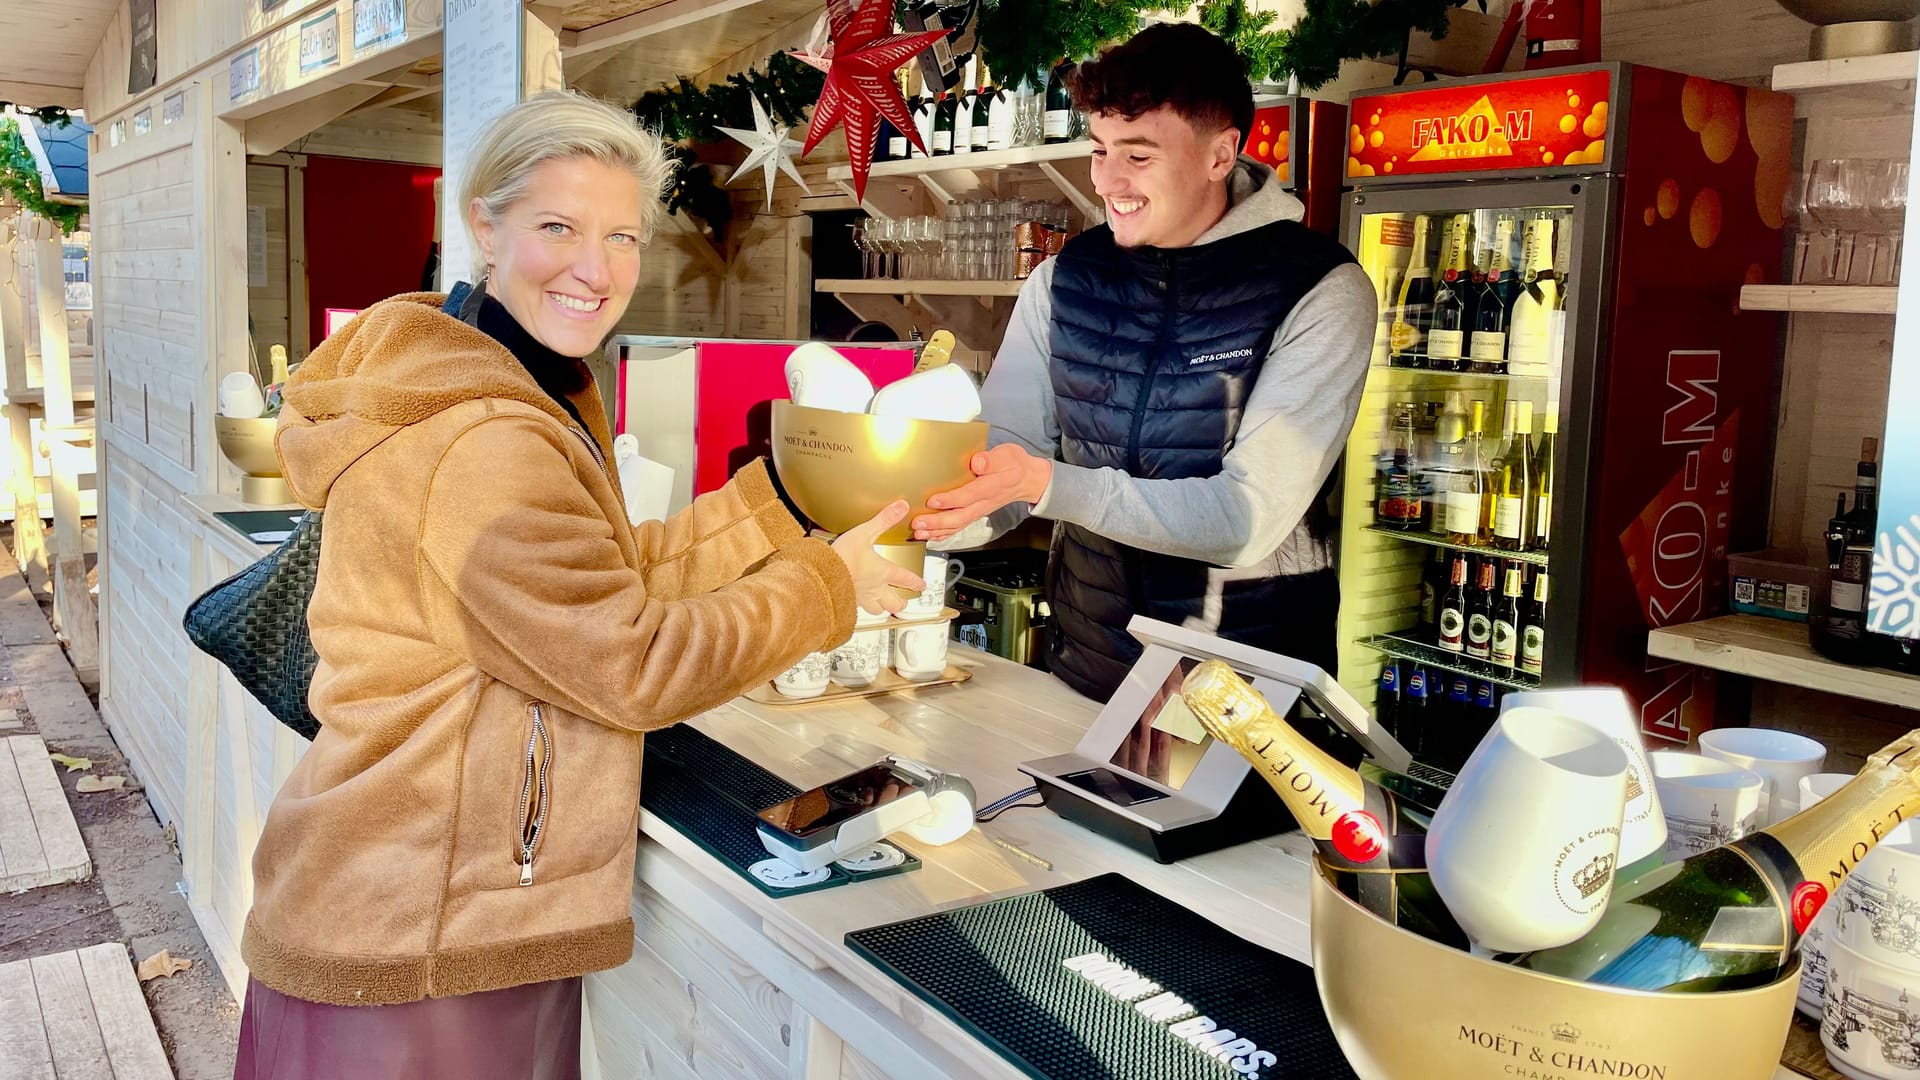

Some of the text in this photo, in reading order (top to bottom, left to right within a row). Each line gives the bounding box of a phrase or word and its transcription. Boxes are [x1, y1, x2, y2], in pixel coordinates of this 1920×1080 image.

[1412, 109, 1533, 149] FAKO-M
[1215, 348, 1253, 361] CHANDON
[808, 440, 854, 453] CHANDON
[1252, 737, 1338, 818] MOËT
[1828, 803, 1905, 889] MOËT
[1134, 990, 1195, 1024] IN
[1168, 1015, 1278, 1080] BARS.
[1457, 1024, 1667, 1080] MOËT & CHANDON
[1511, 1024, 1545, 1037] FRANCE
